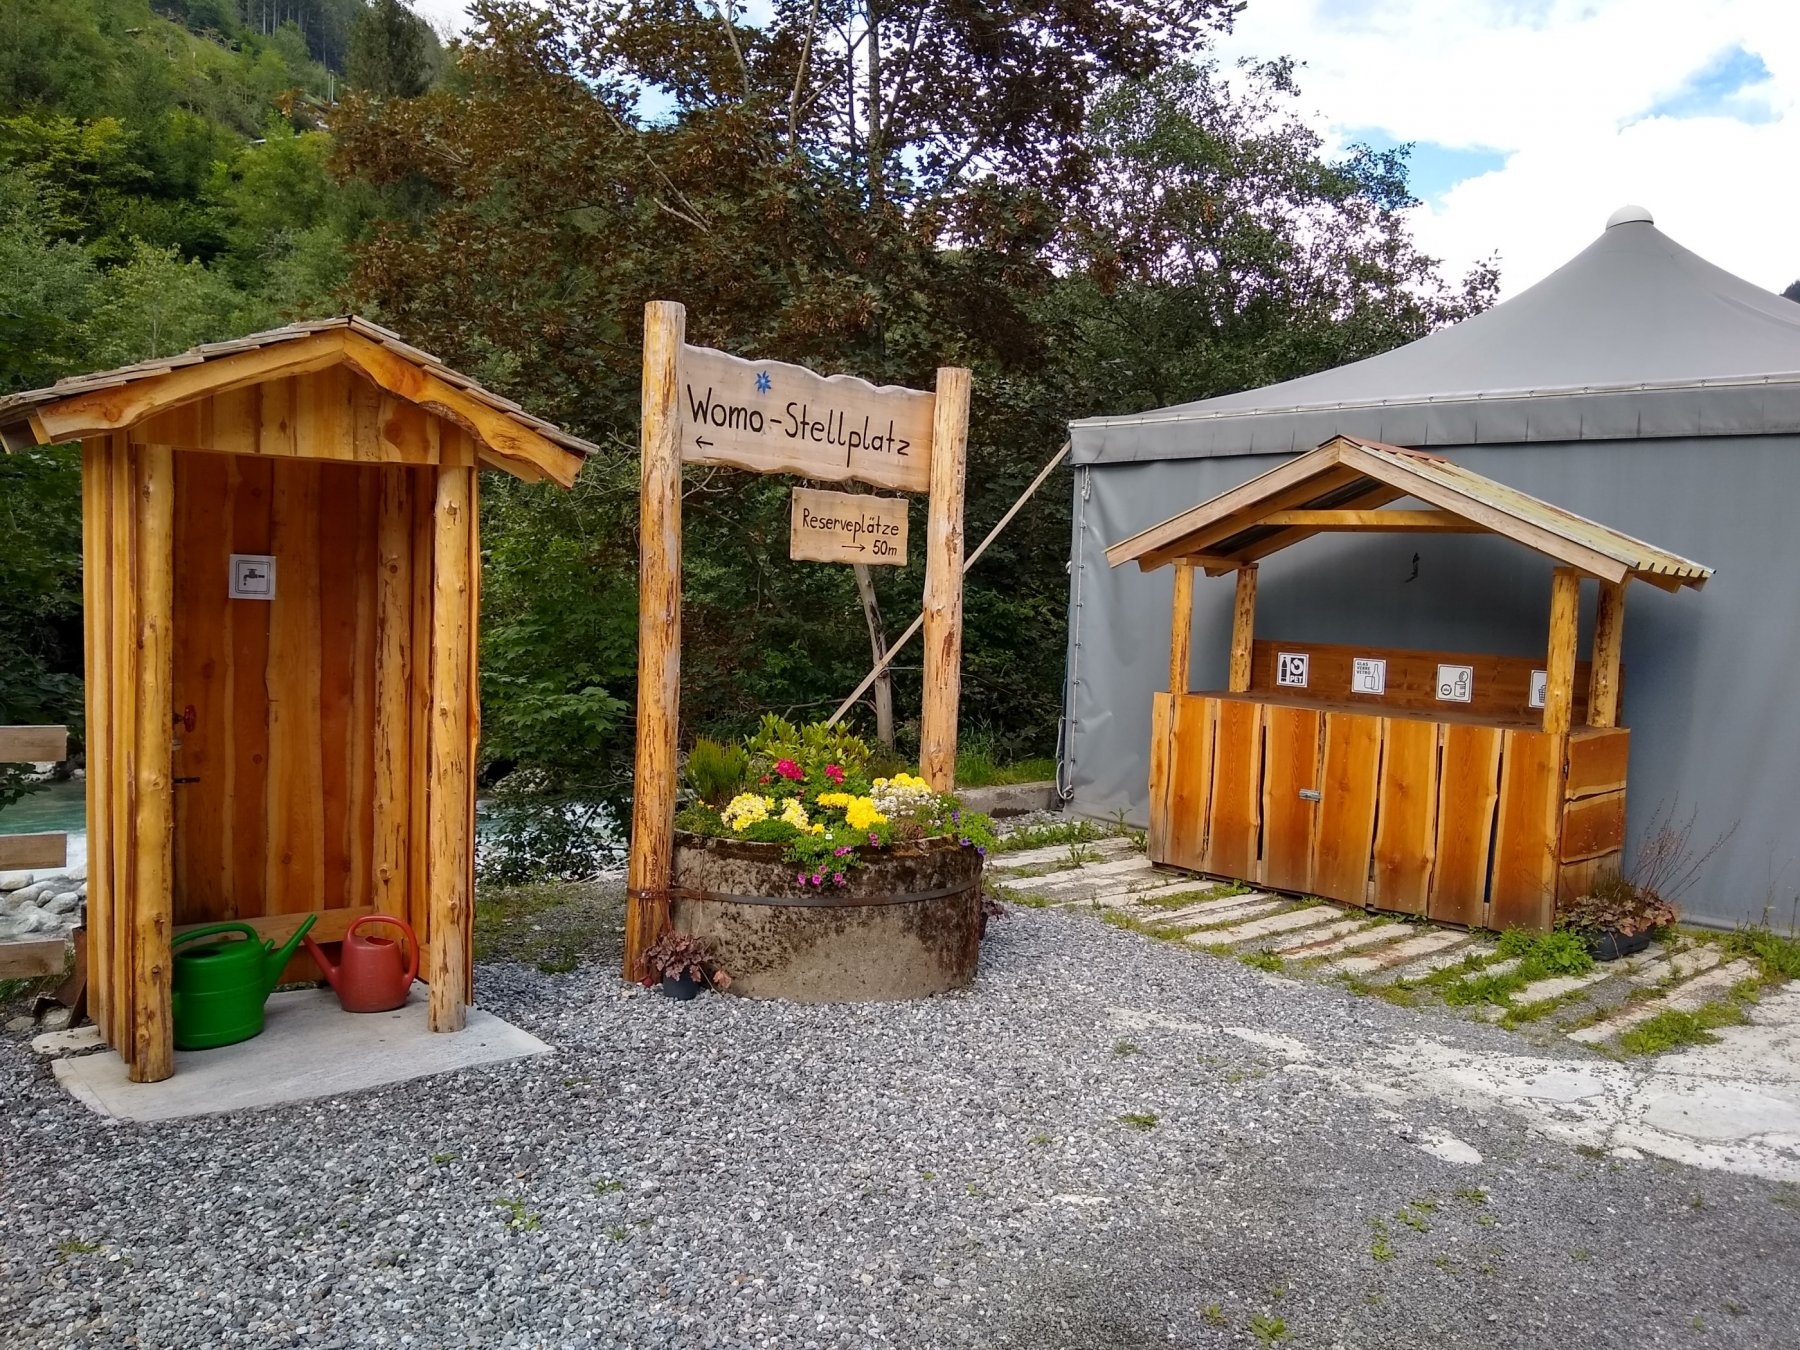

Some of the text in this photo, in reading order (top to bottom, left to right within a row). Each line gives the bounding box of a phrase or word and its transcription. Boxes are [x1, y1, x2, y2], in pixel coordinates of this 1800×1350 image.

[802, 507, 900, 543] Reserveplätze
[872, 539, 898, 556] 50m
[1290, 675, 1303, 683] PET
